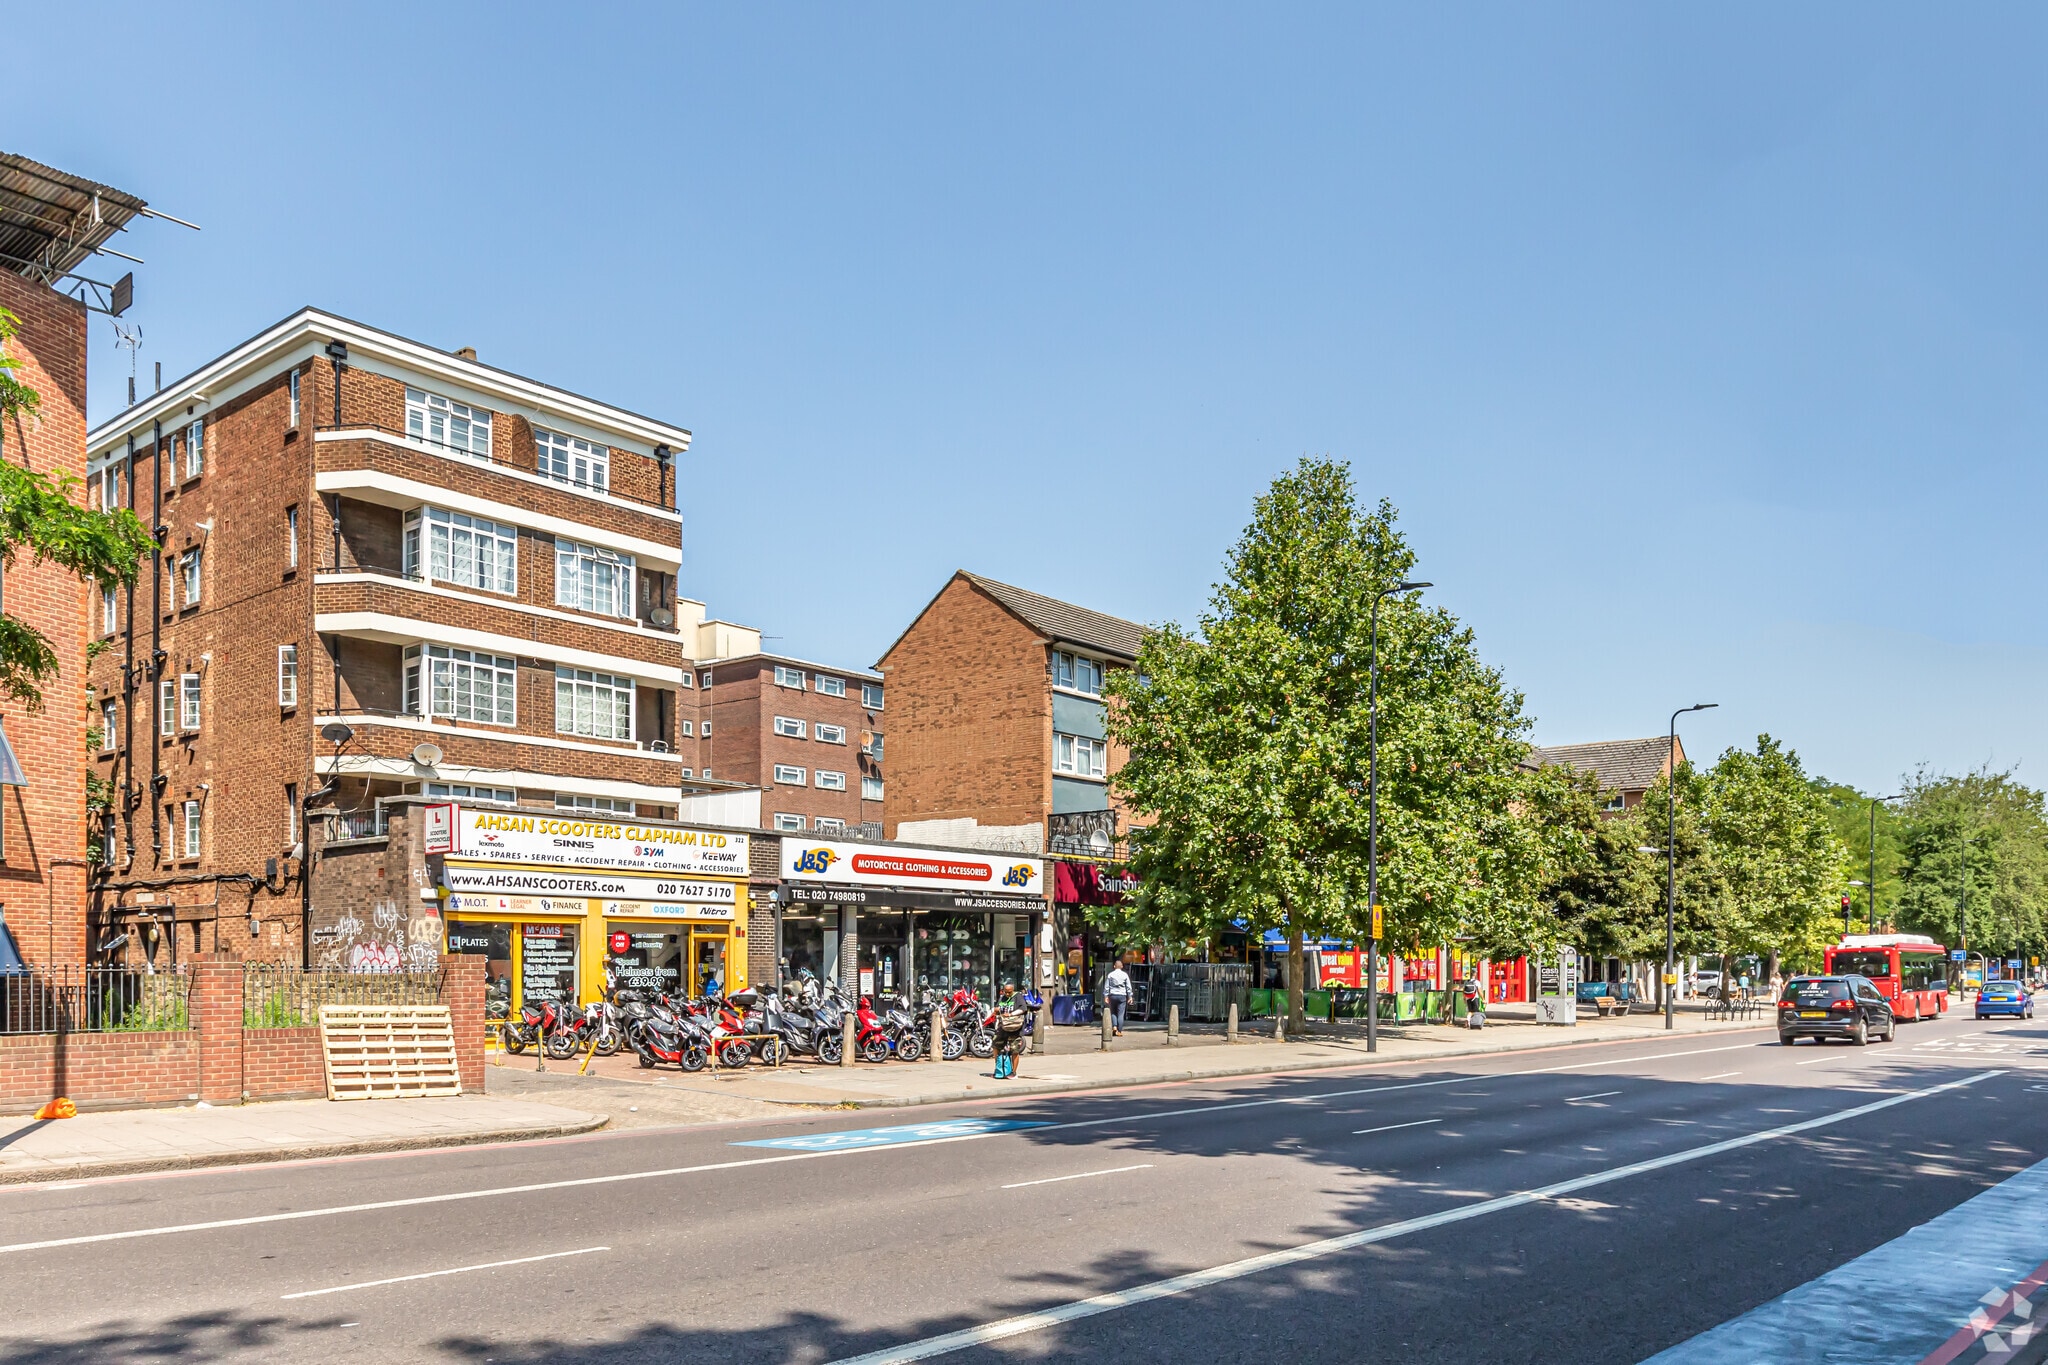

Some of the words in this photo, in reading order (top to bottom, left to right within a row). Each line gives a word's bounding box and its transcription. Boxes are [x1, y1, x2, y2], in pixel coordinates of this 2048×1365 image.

[474, 814, 534, 833] AHSAN
[538, 819, 621, 840] SCOOTERS
[626, 827, 696, 846] CLAPHAM
[701, 832, 727, 848] LTD
[553, 839, 594, 849] SINNIS
[643, 847, 664, 857] SYM
[702, 852, 737, 862] KEEWAY
[490, 851, 521, 860] SPARES
[531, 854, 565, 862] SERVICE
[574, 857, 615, 865] ACCIDENT
[618, 859, 645, 867] REPAIR
[654, 862, 691, 870] CLOTHING
[699, 864, 744, 873] ACCESSORIES
[794, 850, 829, 873] J&S
[858, 860, 903, 871] MOTORCYCLE
[906, 863, 939, 873] CLOTHING
[948, 867, 987, 876] ACCESSORIES
[1002, 866, 1029, 887] J&S
[657, 884, 676, 894] 020
[680, 885, 704, 896] 7627
[707, 886, 731, 898] 5170
[792, 890, 810, 899] TEL:
[812, 890, 826, 900] 020
[829, 892, 866, 901] 74980819
[464, 898, 488, 907] M.O.T.
[500, 900, 506, 908] L
[553, 901, 582, 910] FINANCE
[955, 898, 1046, 910] WWW.JSACCESSORIES.CO.UK
[654, 906, 685, 914] OXFORD
[700, 907, 728, 916] Nitro
[461, 938, 488, 946] PLATES
[1321, 954, 1337, 967] great
[1338, 954, 1353, 966] value
[615, 966, 653, 976] Helmets
[655, 966, 677, 976] from
[629, 977, 665, 987] £39.99
